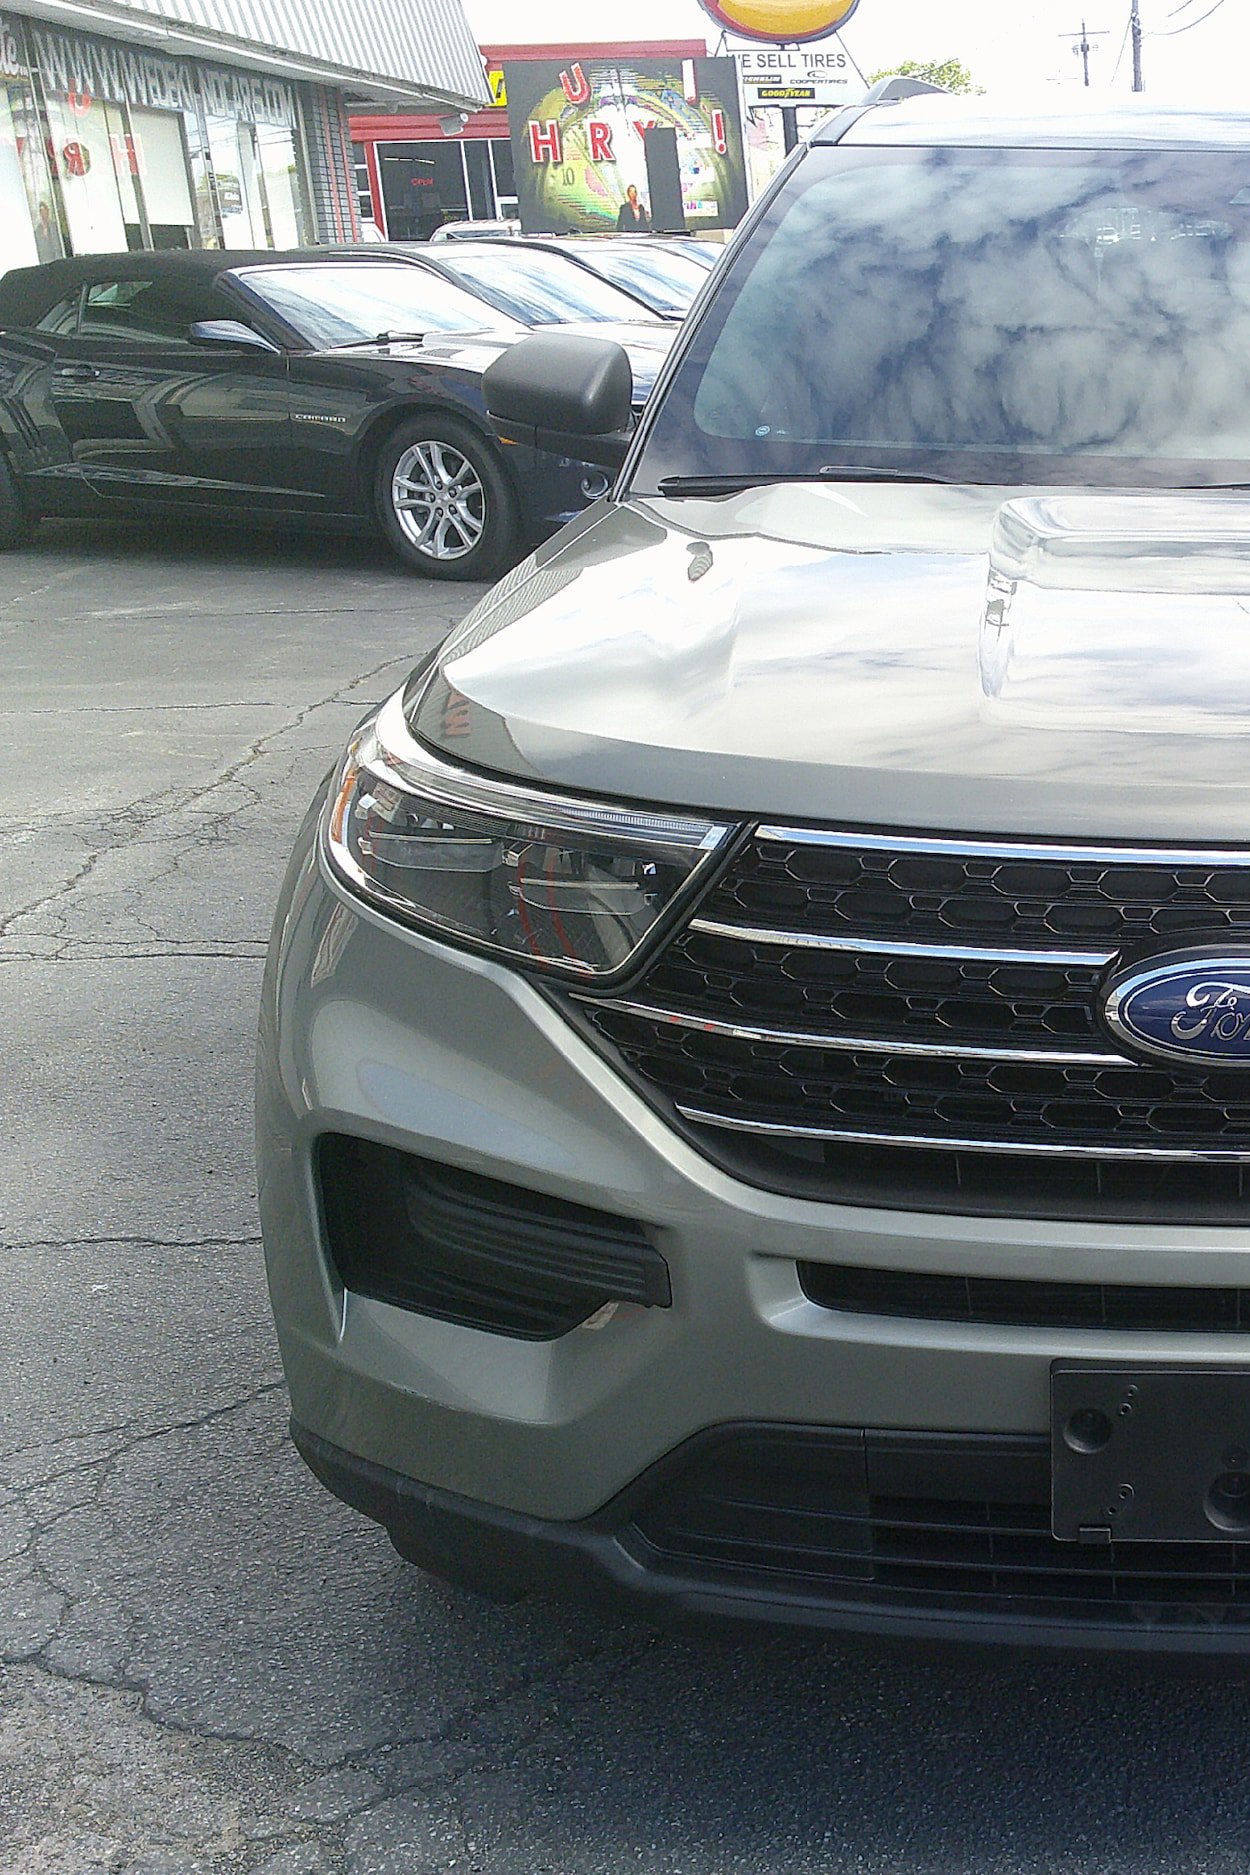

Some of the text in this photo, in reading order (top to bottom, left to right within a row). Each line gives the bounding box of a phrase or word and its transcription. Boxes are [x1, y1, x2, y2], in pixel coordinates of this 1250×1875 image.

[757, 54, 796, 68] SELL
[801, 54, 846, 68] TIRES
[762, 89, 811, 98] GOODYEAR
